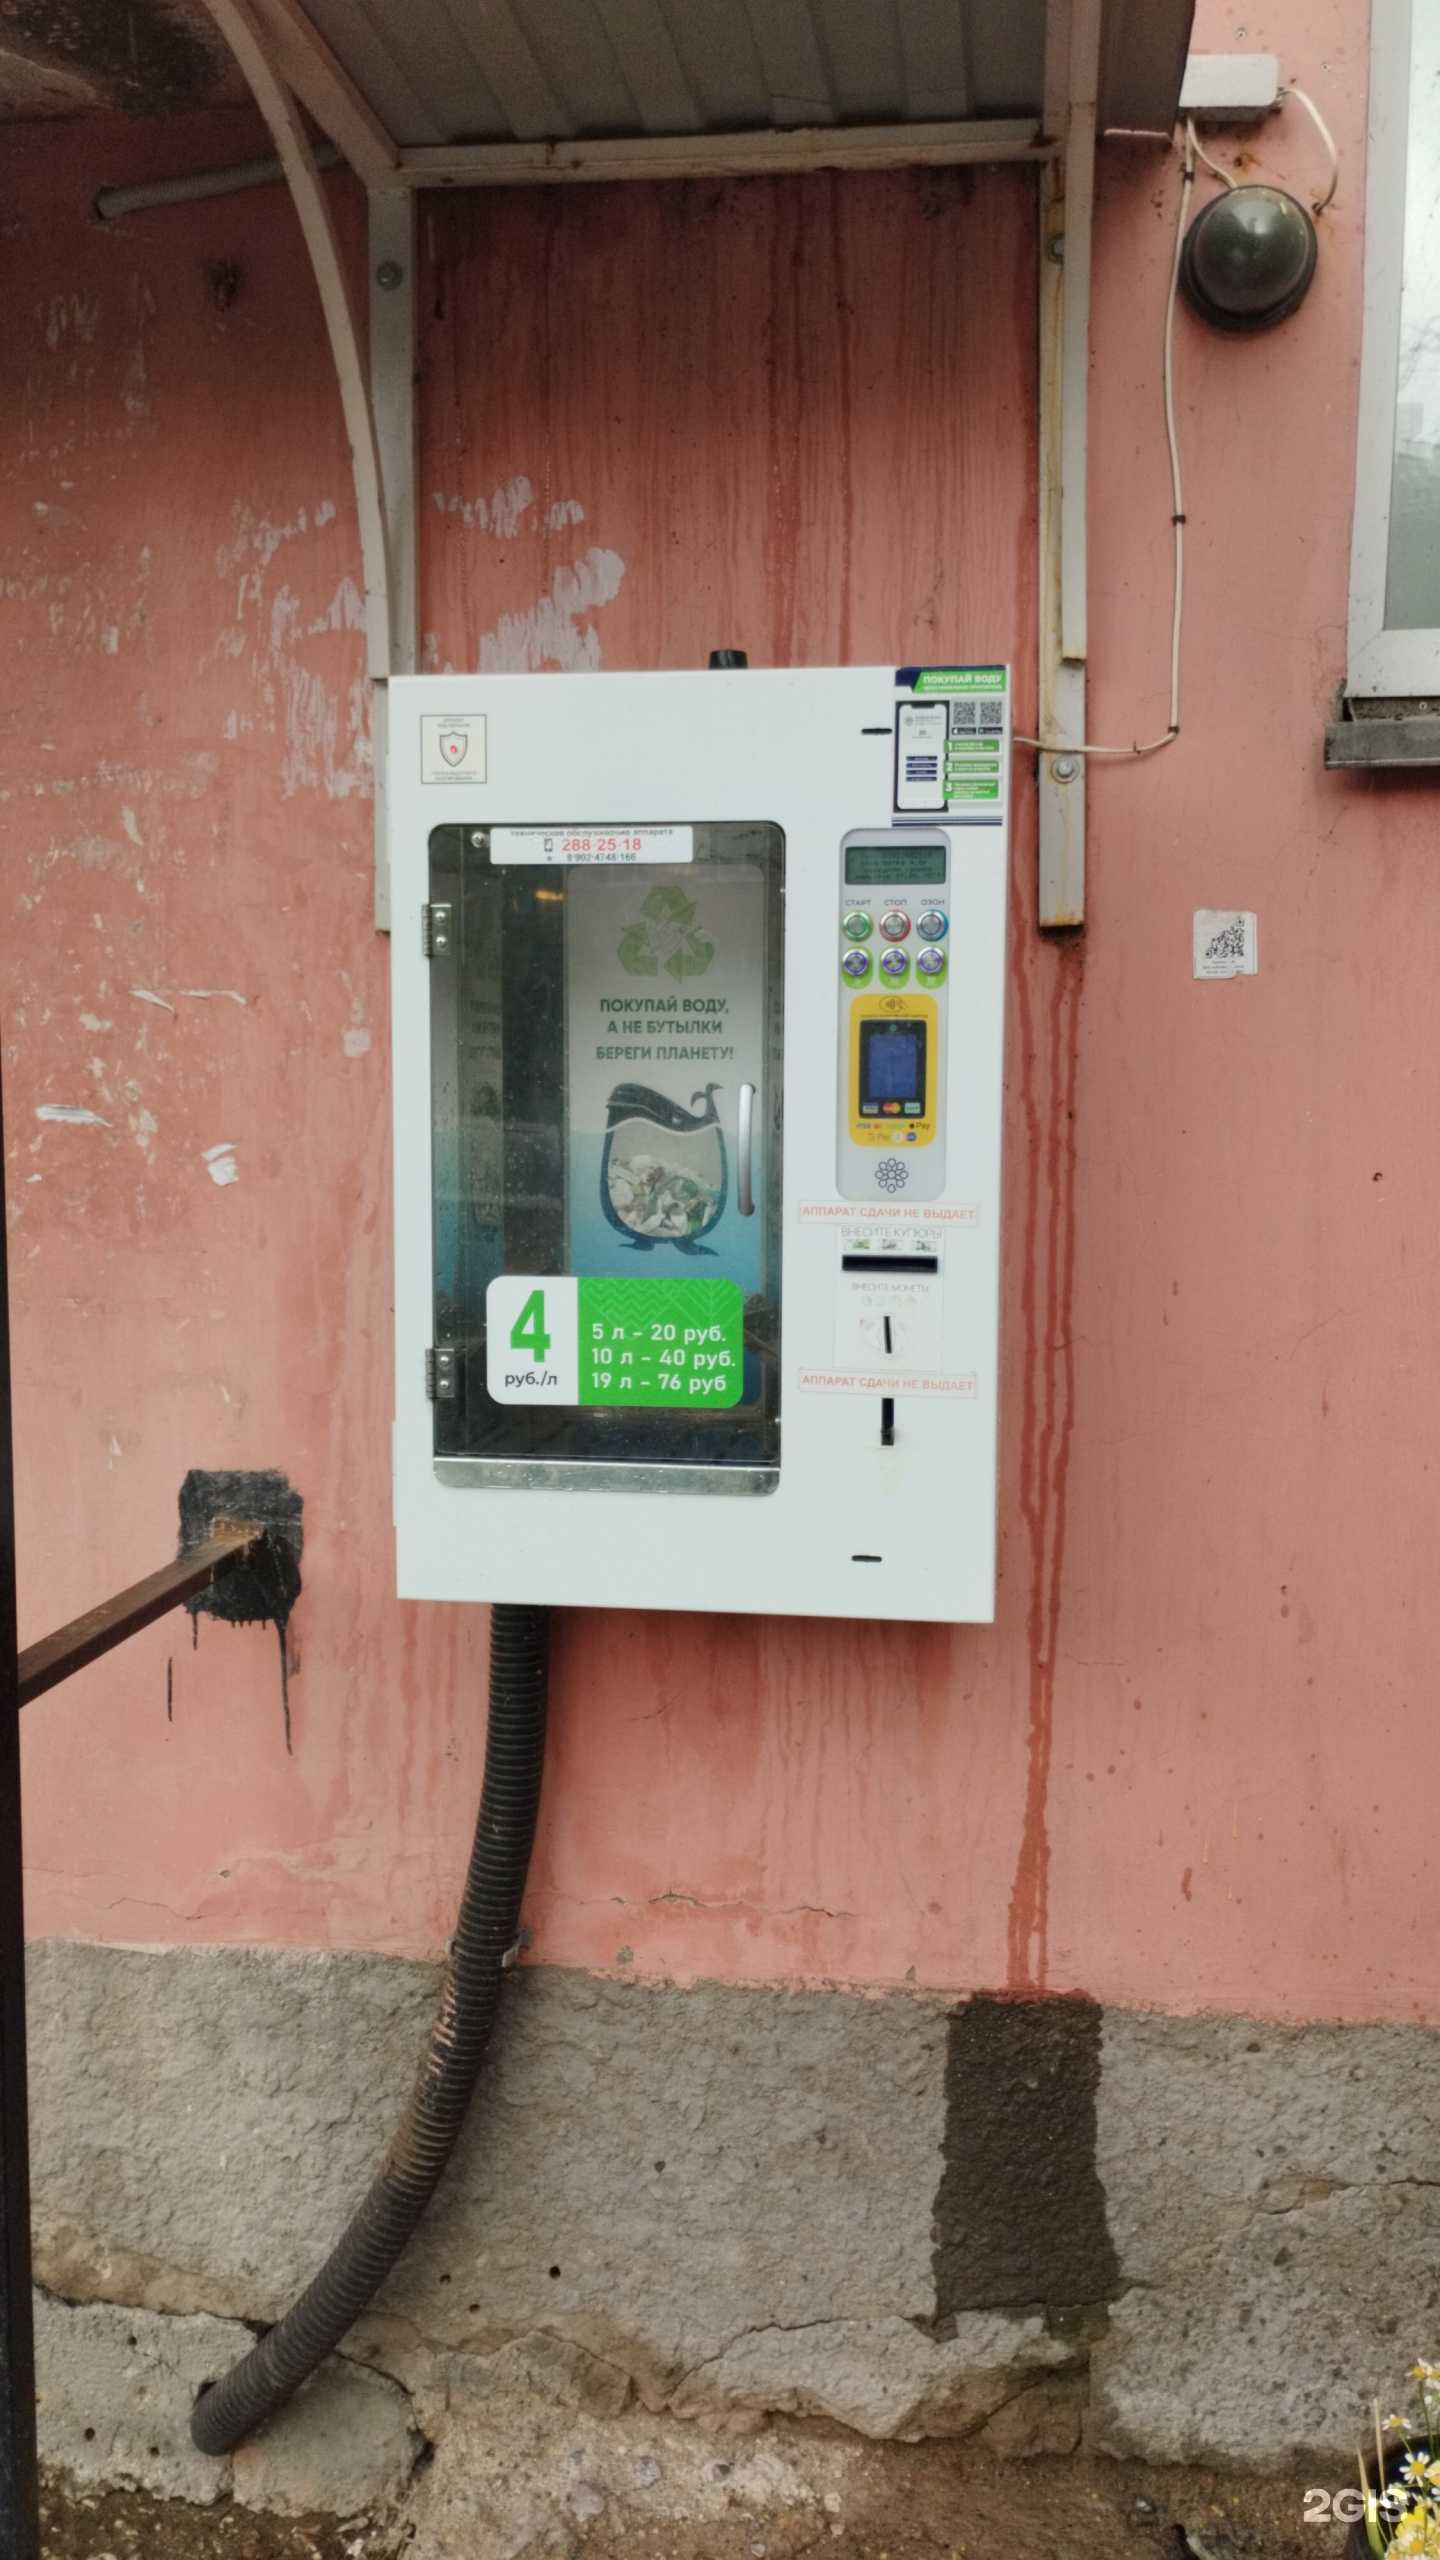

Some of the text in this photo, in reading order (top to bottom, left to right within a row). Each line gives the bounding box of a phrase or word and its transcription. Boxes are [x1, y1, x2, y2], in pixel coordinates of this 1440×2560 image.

[924, 673, 1001, 684] ПОКУПАЙ ВОДУ
[561, 837, 642, 852] 288 25 18
[601, 996, 729, 1014] ПОКУПАЙ ВОДУ,
[607, 1021, 722, 1034] А НЕ БУТЫЛКИ
[596, 1046, 735, 1060] БЕРЕГИ ПЛАНЕТУ!
[802, 1206, 857, 1217] АППАРАТ
[860, 1206, 901, 1218] СДАЧИ
[903, 1207, 919, 1218] НЕ
[510, 1290, 551, 1363] 4
[592, 1324, 604, 1340] 5
[611, 1327, 624, 1340] л
[651, 1324, 676, 1342] 20
[684, 1325, 726, 1346] руб.
[592, 1348, 612, 1365] 10
[619, 1352, 633, 1365] л
[659, 1349, 685, 1366] 40
[693, 1350, 736, 1370] руб.
[504, 1371, 558, 1388] руб./л
[592, 1372, 612, 1389] 19
[619, 1376, 632, 1389] л
[658, 1373, 681, 1390] 76
[688, 1374, 726, 1395] руб
[802, 1375, 974, 1392] АППАРАТ СДАЧИ НЕ ВЫДАЕТ
